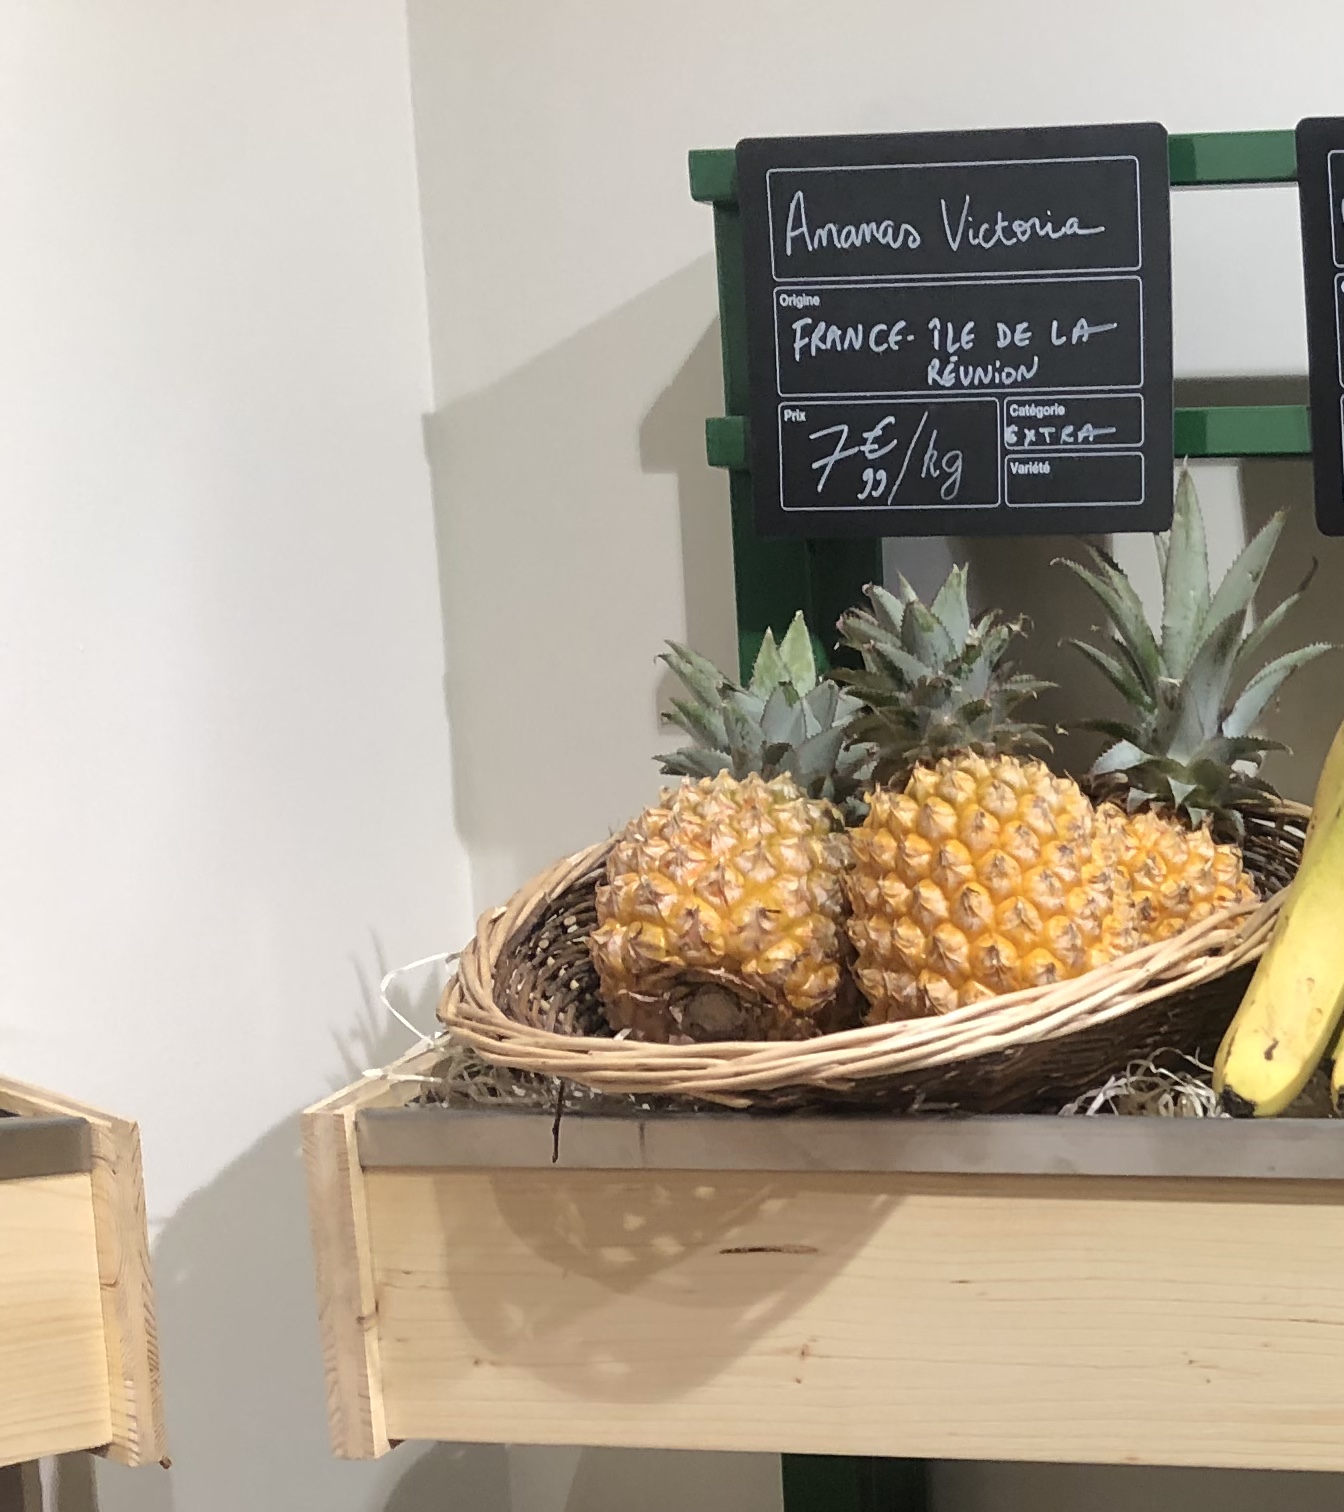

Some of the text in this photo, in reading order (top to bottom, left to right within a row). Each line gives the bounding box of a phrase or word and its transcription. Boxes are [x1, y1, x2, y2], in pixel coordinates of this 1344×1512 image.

[785, 190, 1105, 256] Ananas Victoria
[779, 293, 820, 308] Origine
[928, 317, 976, 351] ÎLE
[997, 321, 1033, 347] DE
[1051, 317, 1117, 346] LA
[783, 409, 806, 422] Prix
[1009, 403, 1066, 418] Catégorie
[1010, 461, 1051, 475] Variété
